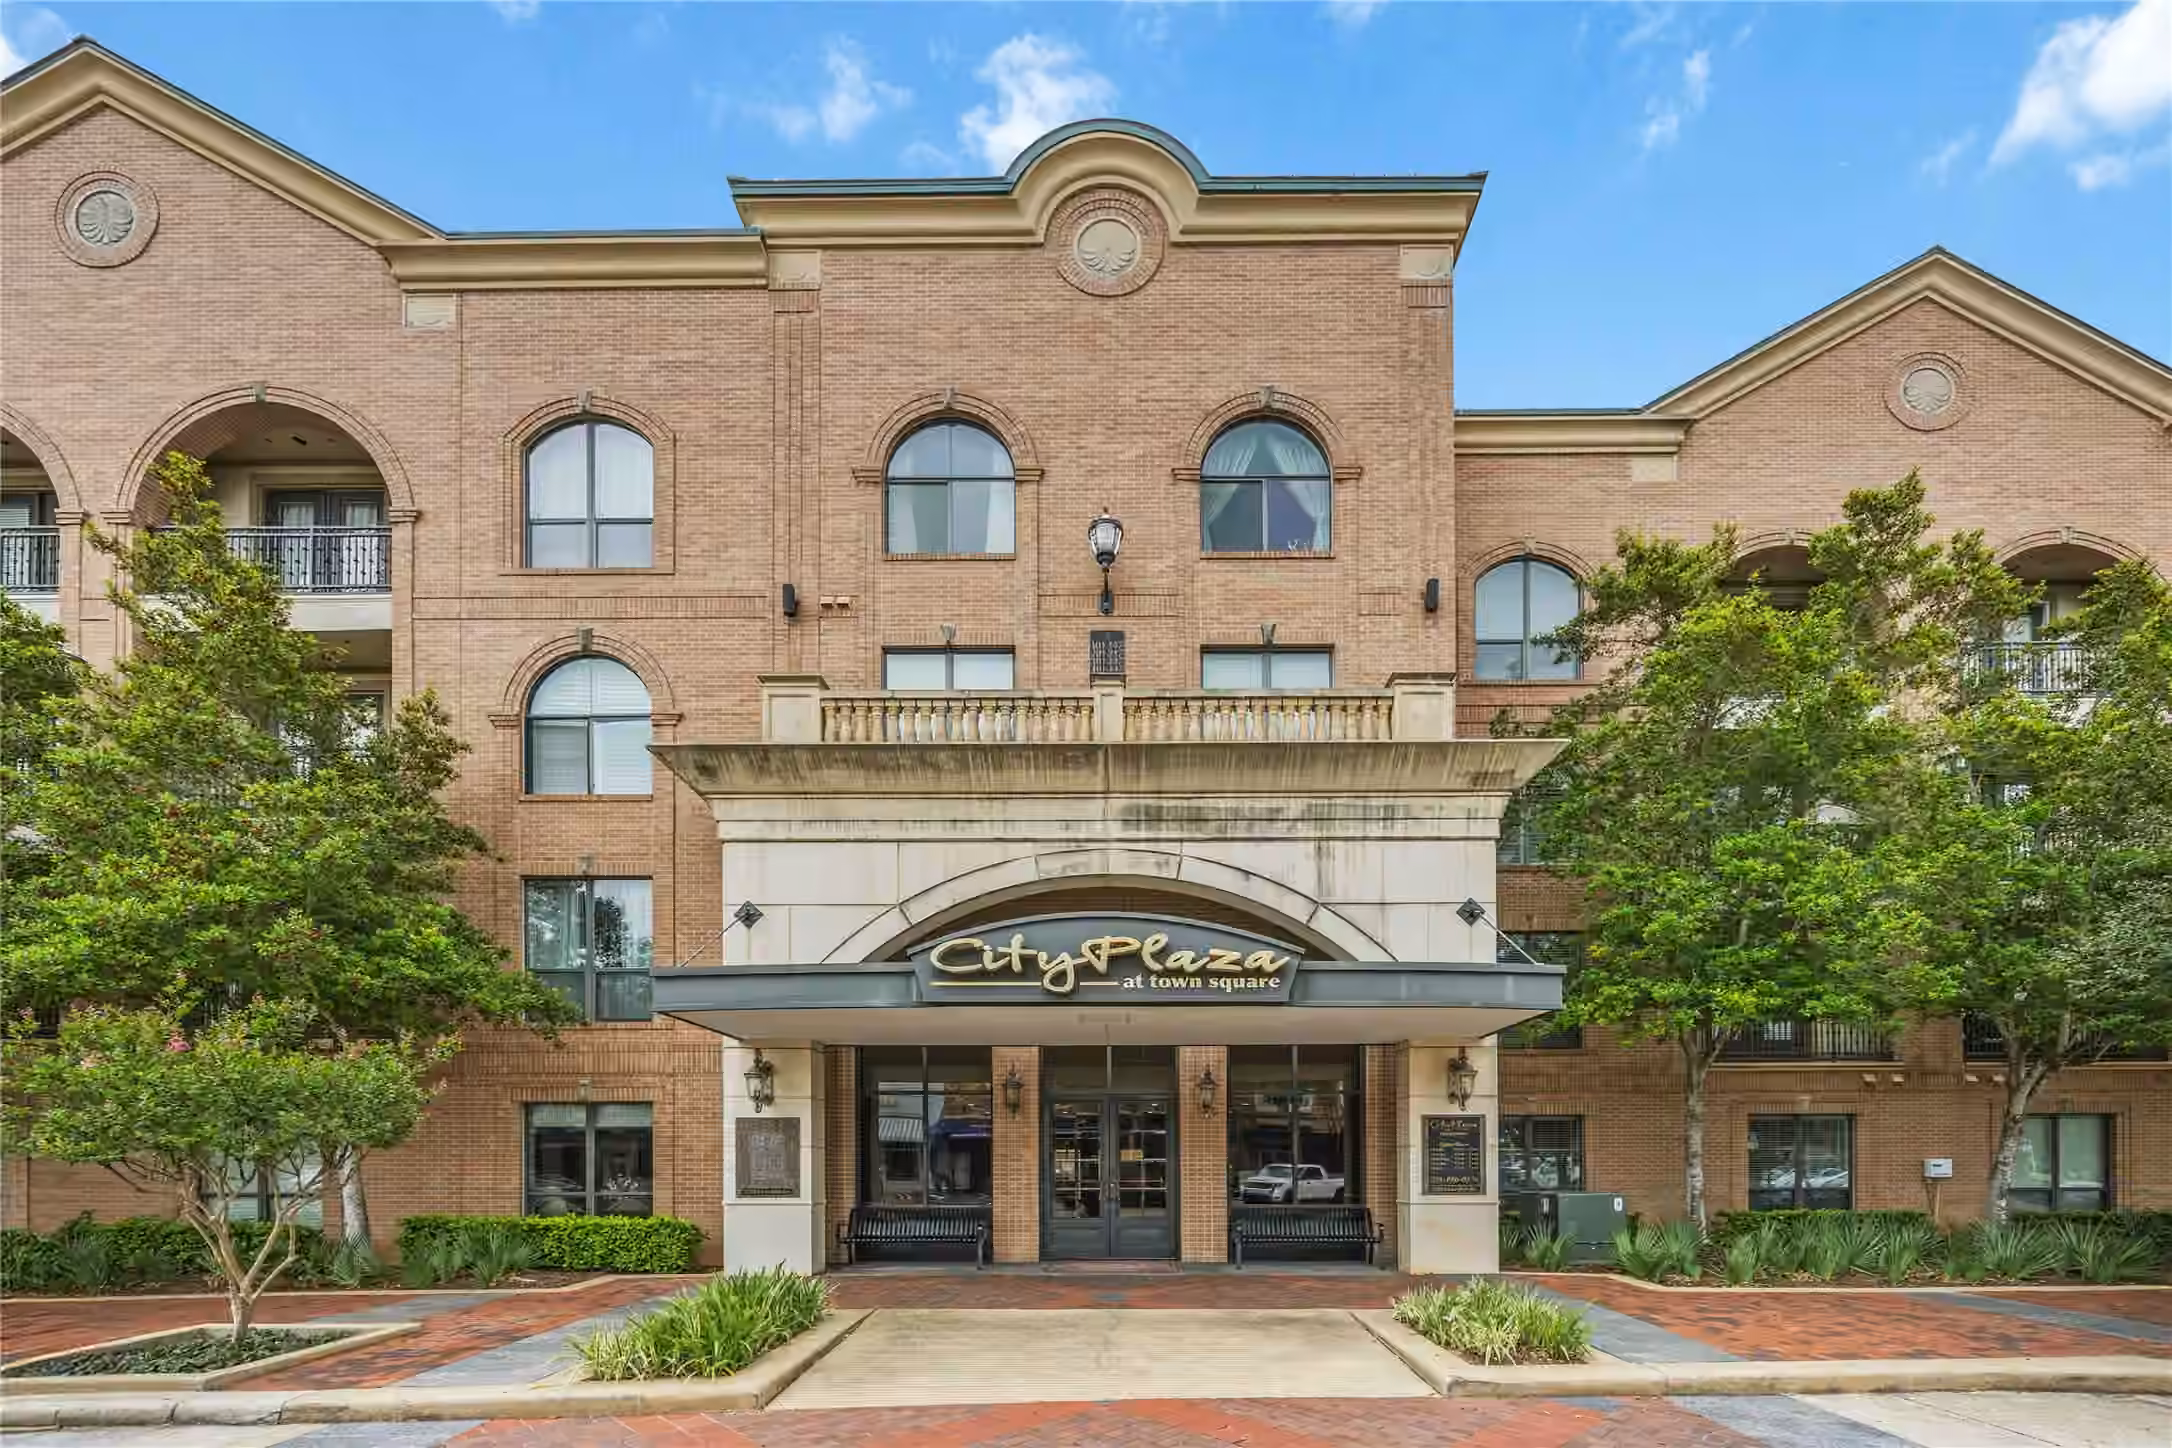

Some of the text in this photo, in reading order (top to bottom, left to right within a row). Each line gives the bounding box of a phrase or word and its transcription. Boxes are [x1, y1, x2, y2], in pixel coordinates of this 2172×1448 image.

[930, 933, 1291, 993] City Plaza
[1122, 973, 1281, 993] at town square
